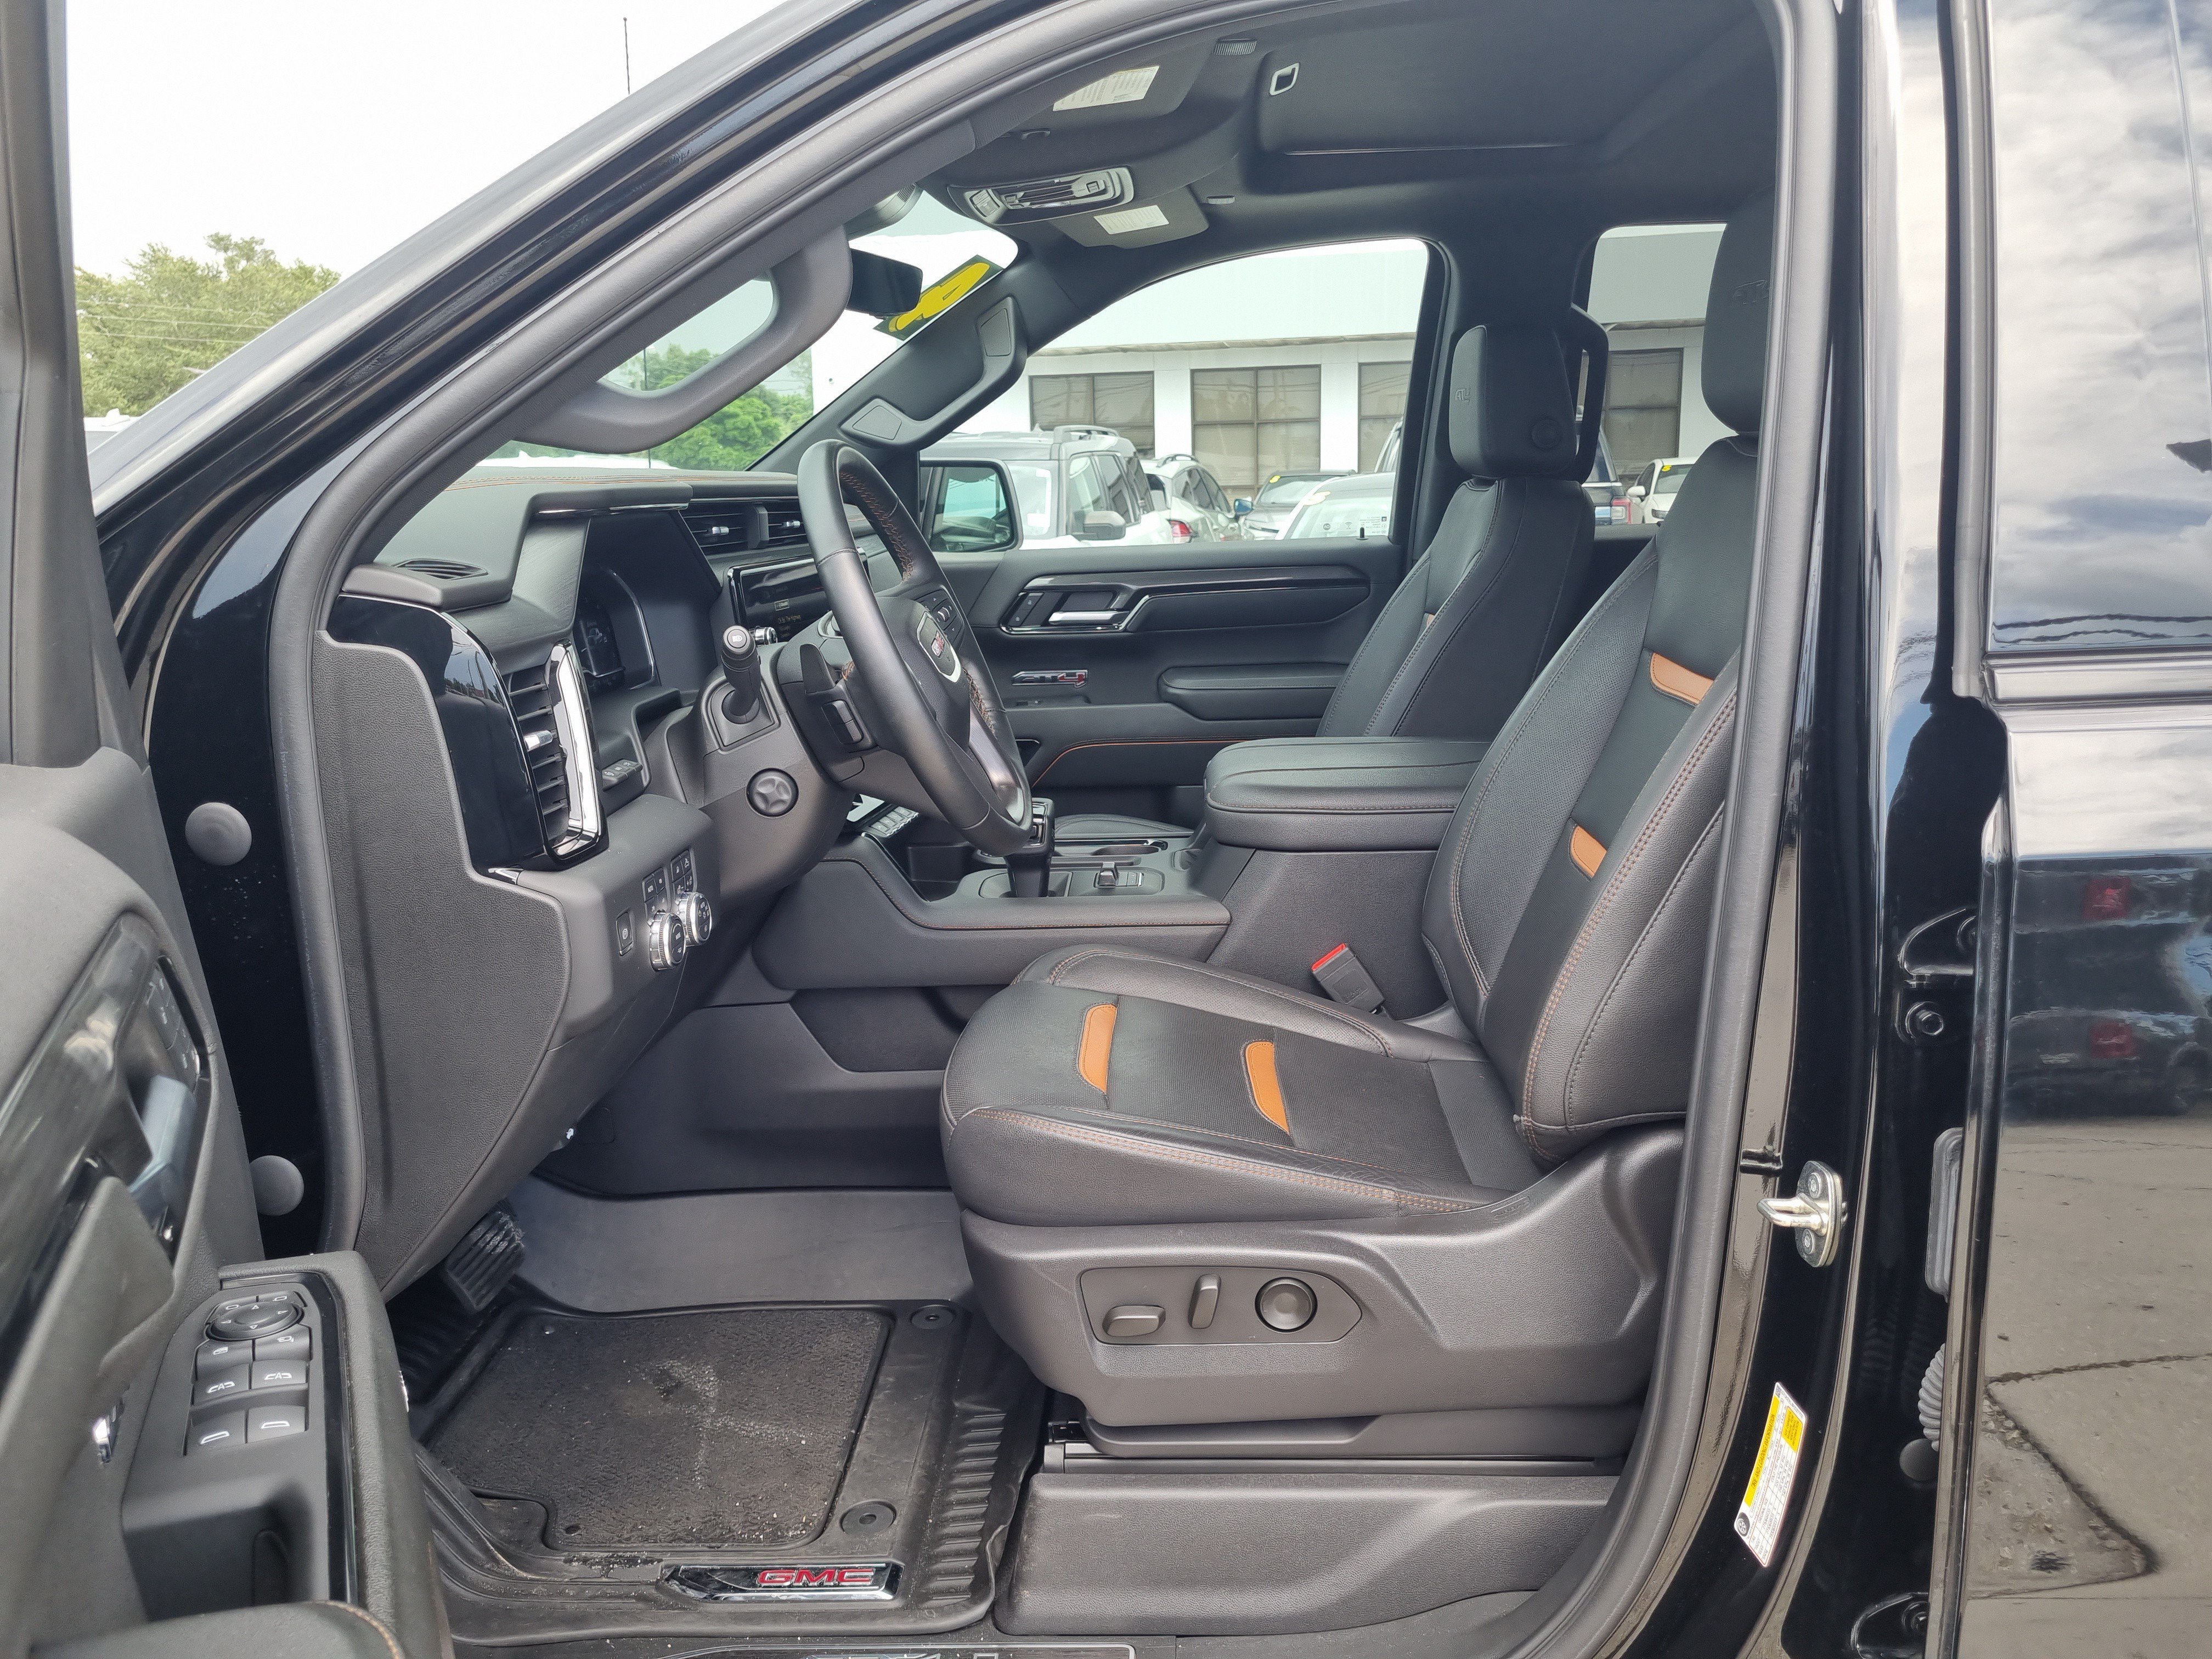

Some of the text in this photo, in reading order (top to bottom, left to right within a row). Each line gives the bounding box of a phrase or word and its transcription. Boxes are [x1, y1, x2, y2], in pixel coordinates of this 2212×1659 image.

[1758, 1444, 1767, 1468] LOADING
[1764, 1414, 1775, 1446] INFORMATION
[757, 1567, 876, 1587] GMC
